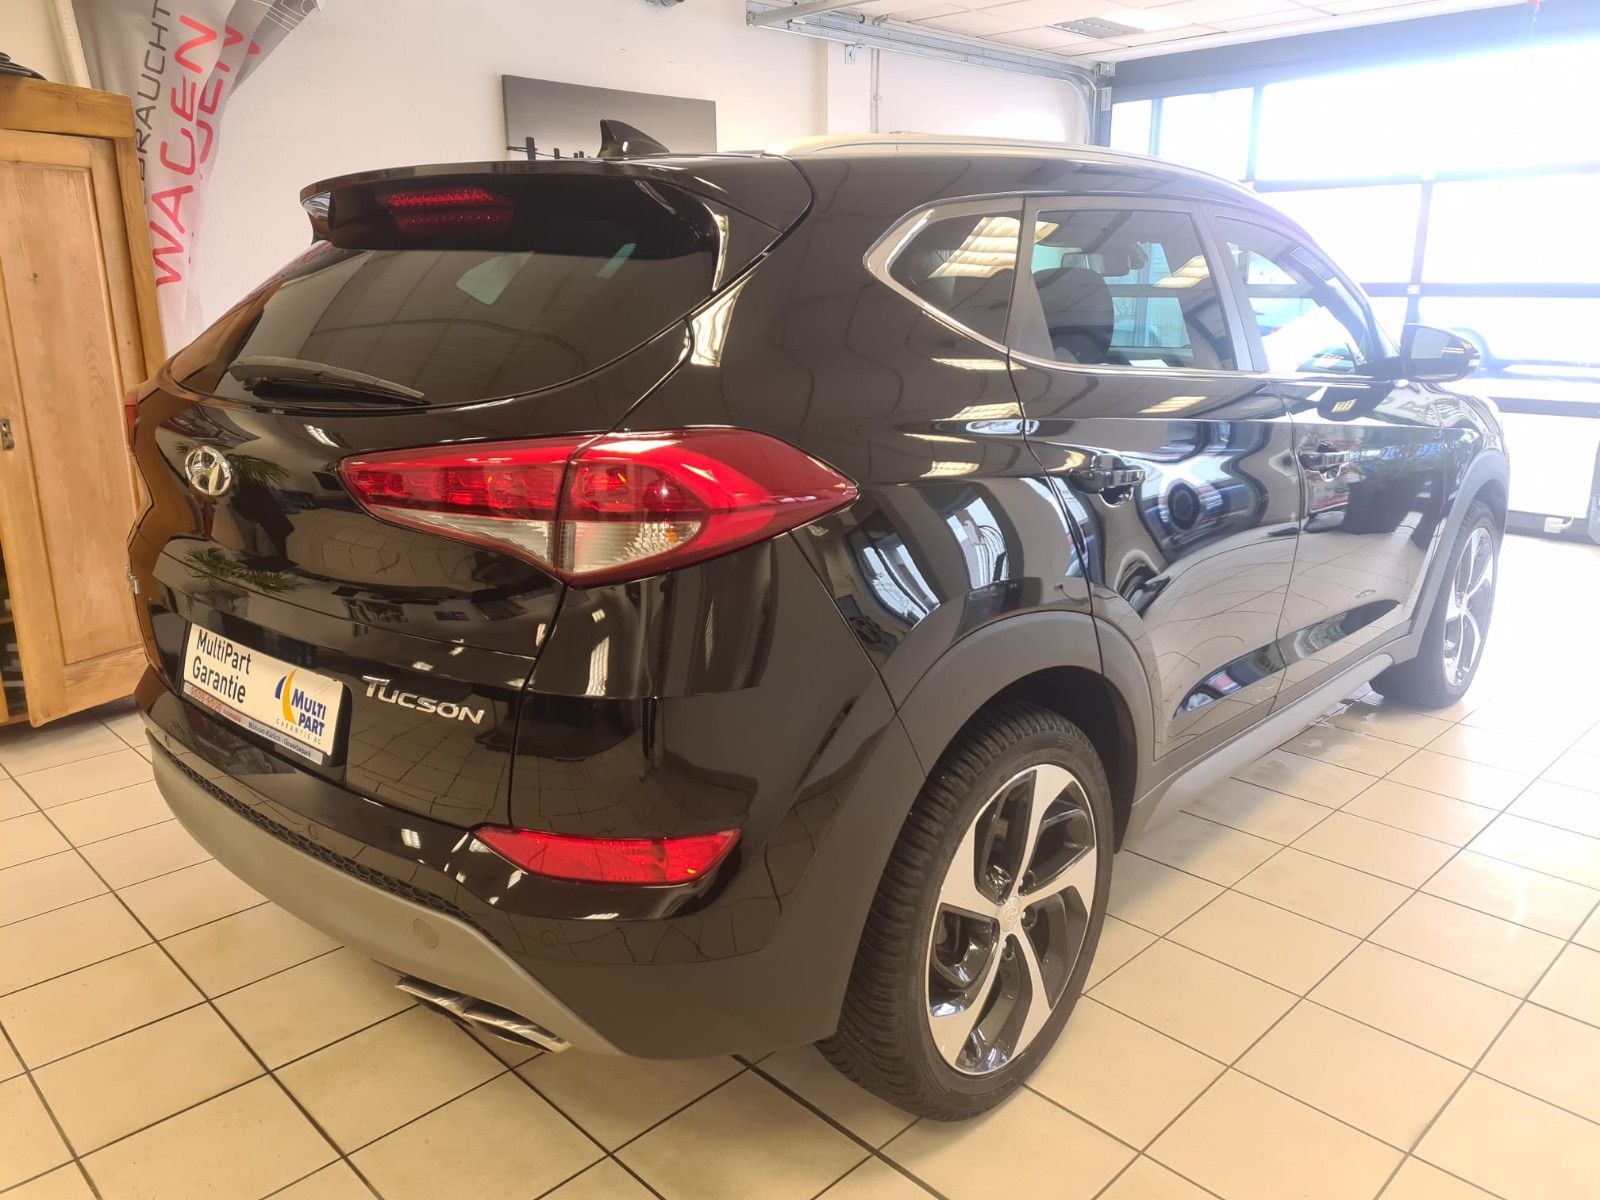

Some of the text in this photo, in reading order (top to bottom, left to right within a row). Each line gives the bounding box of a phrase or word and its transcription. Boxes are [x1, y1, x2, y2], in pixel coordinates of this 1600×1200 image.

[196, 628, 252, 675] MultiPart
[192, 656, 246, 704] Garantie
[291, 688, 327, 720] MULTI
[361, 675, 485, 725] TUCSON
[275, 718, 322, 745] GARANTIE AG
[298, 712, 326, 737] PART
